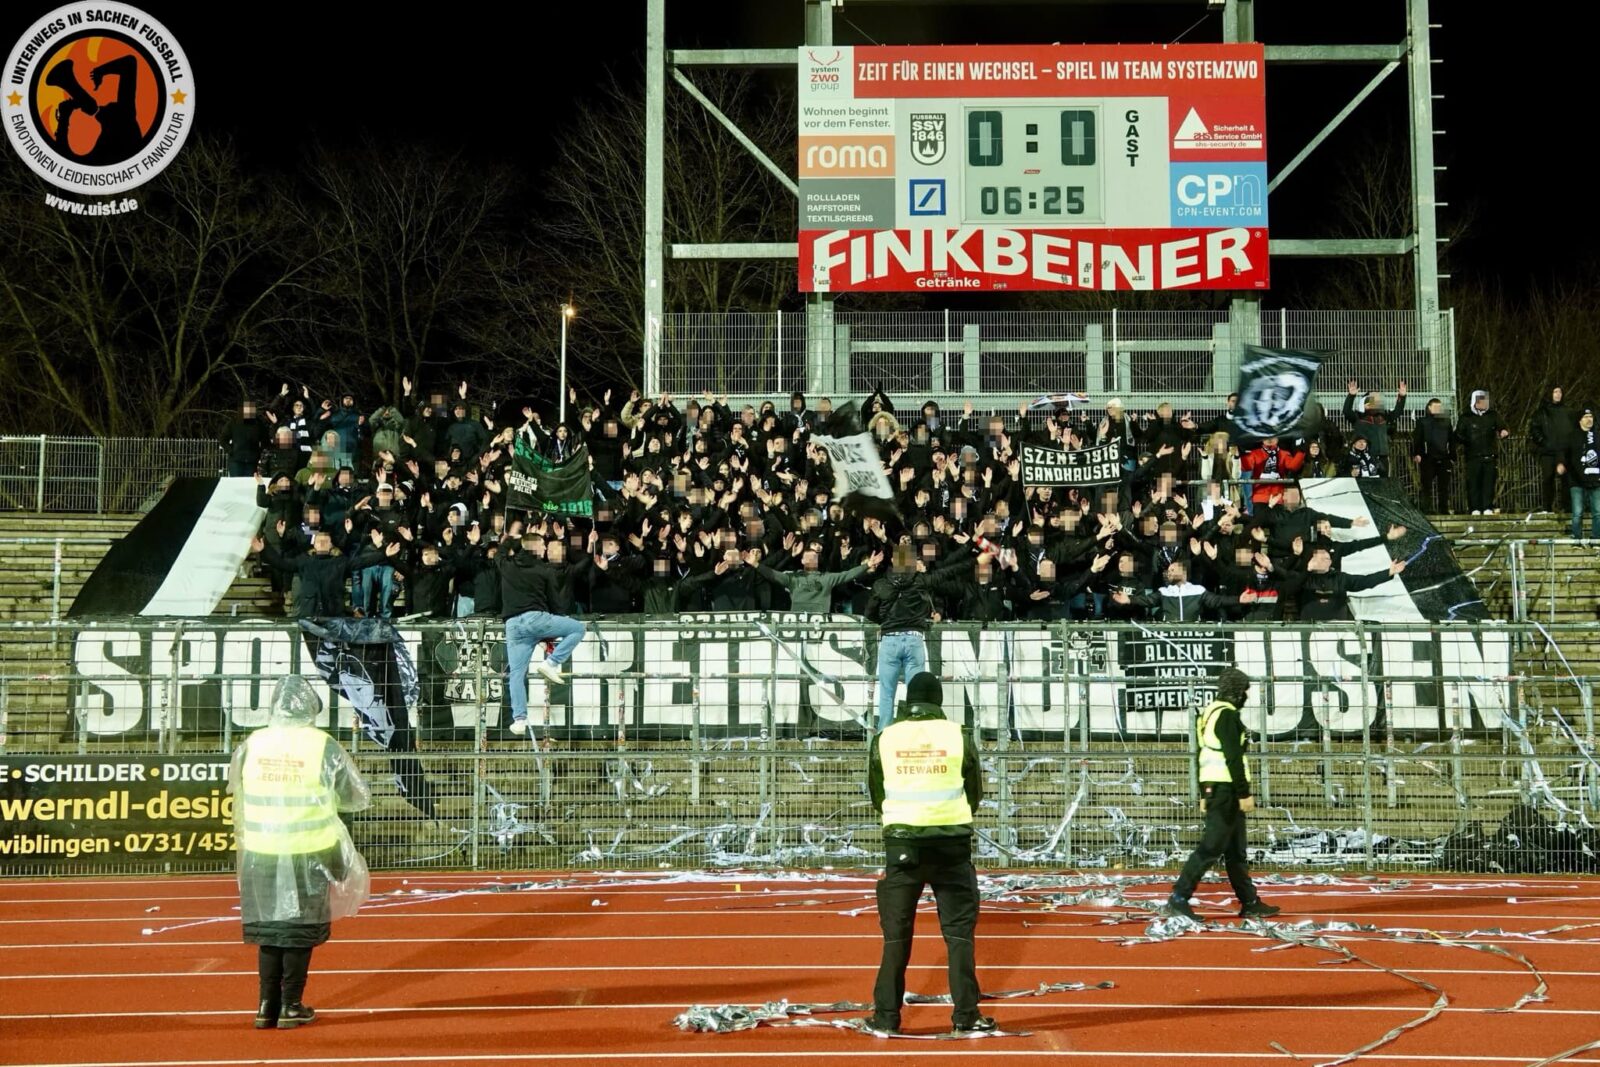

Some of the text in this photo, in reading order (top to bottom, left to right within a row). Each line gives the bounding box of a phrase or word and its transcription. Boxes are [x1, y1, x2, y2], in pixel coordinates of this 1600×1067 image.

[811, 66, 839, 74] system
[858, 63, 888, 81] ZEIT
[893, 60, 919, 81] FÜR
[924, 63, 964, 80] EINEN
[969, 62, 1038, 80] WECHSEL
[1056, 62, 1096, 79] SPIEL
[1101, 62, 1119, 79] IM
[1124, 61, 1163, 79] TEAM
[1167, 60, 1258, 79] SYSTEMZWO
[811, 83, 839, 92] group
[803, 106, 888, 118] Wohnen beginnt
[804, 119, 891, 128] vor dem Fenster.
[912, 121, 944, 131] SSV
[912, 131, 944, 141] 1846
[1125, 110, 1140, 167] GAST
[806, 144, 888, 169] roma
[981, 186, 1085, 215] 06:25
[1177, 207, 1262, 217] CPN-EVENT.COM
[807, 215, 874, 223] TEXTILSCREENS
[813, 227, 1253, 292] FINKBEINER
[916, 277, 981, 288] Getränke
[1024, 443, 1119, 465] SZENE 1916
[1025, 462, 1120, 482] SANDHAUSEN
[1145, 643, 1214, 661] ALLEINE
[25, 763, 147, 783] SCHILDER
[896, 765, 948, 774] STEWARD
